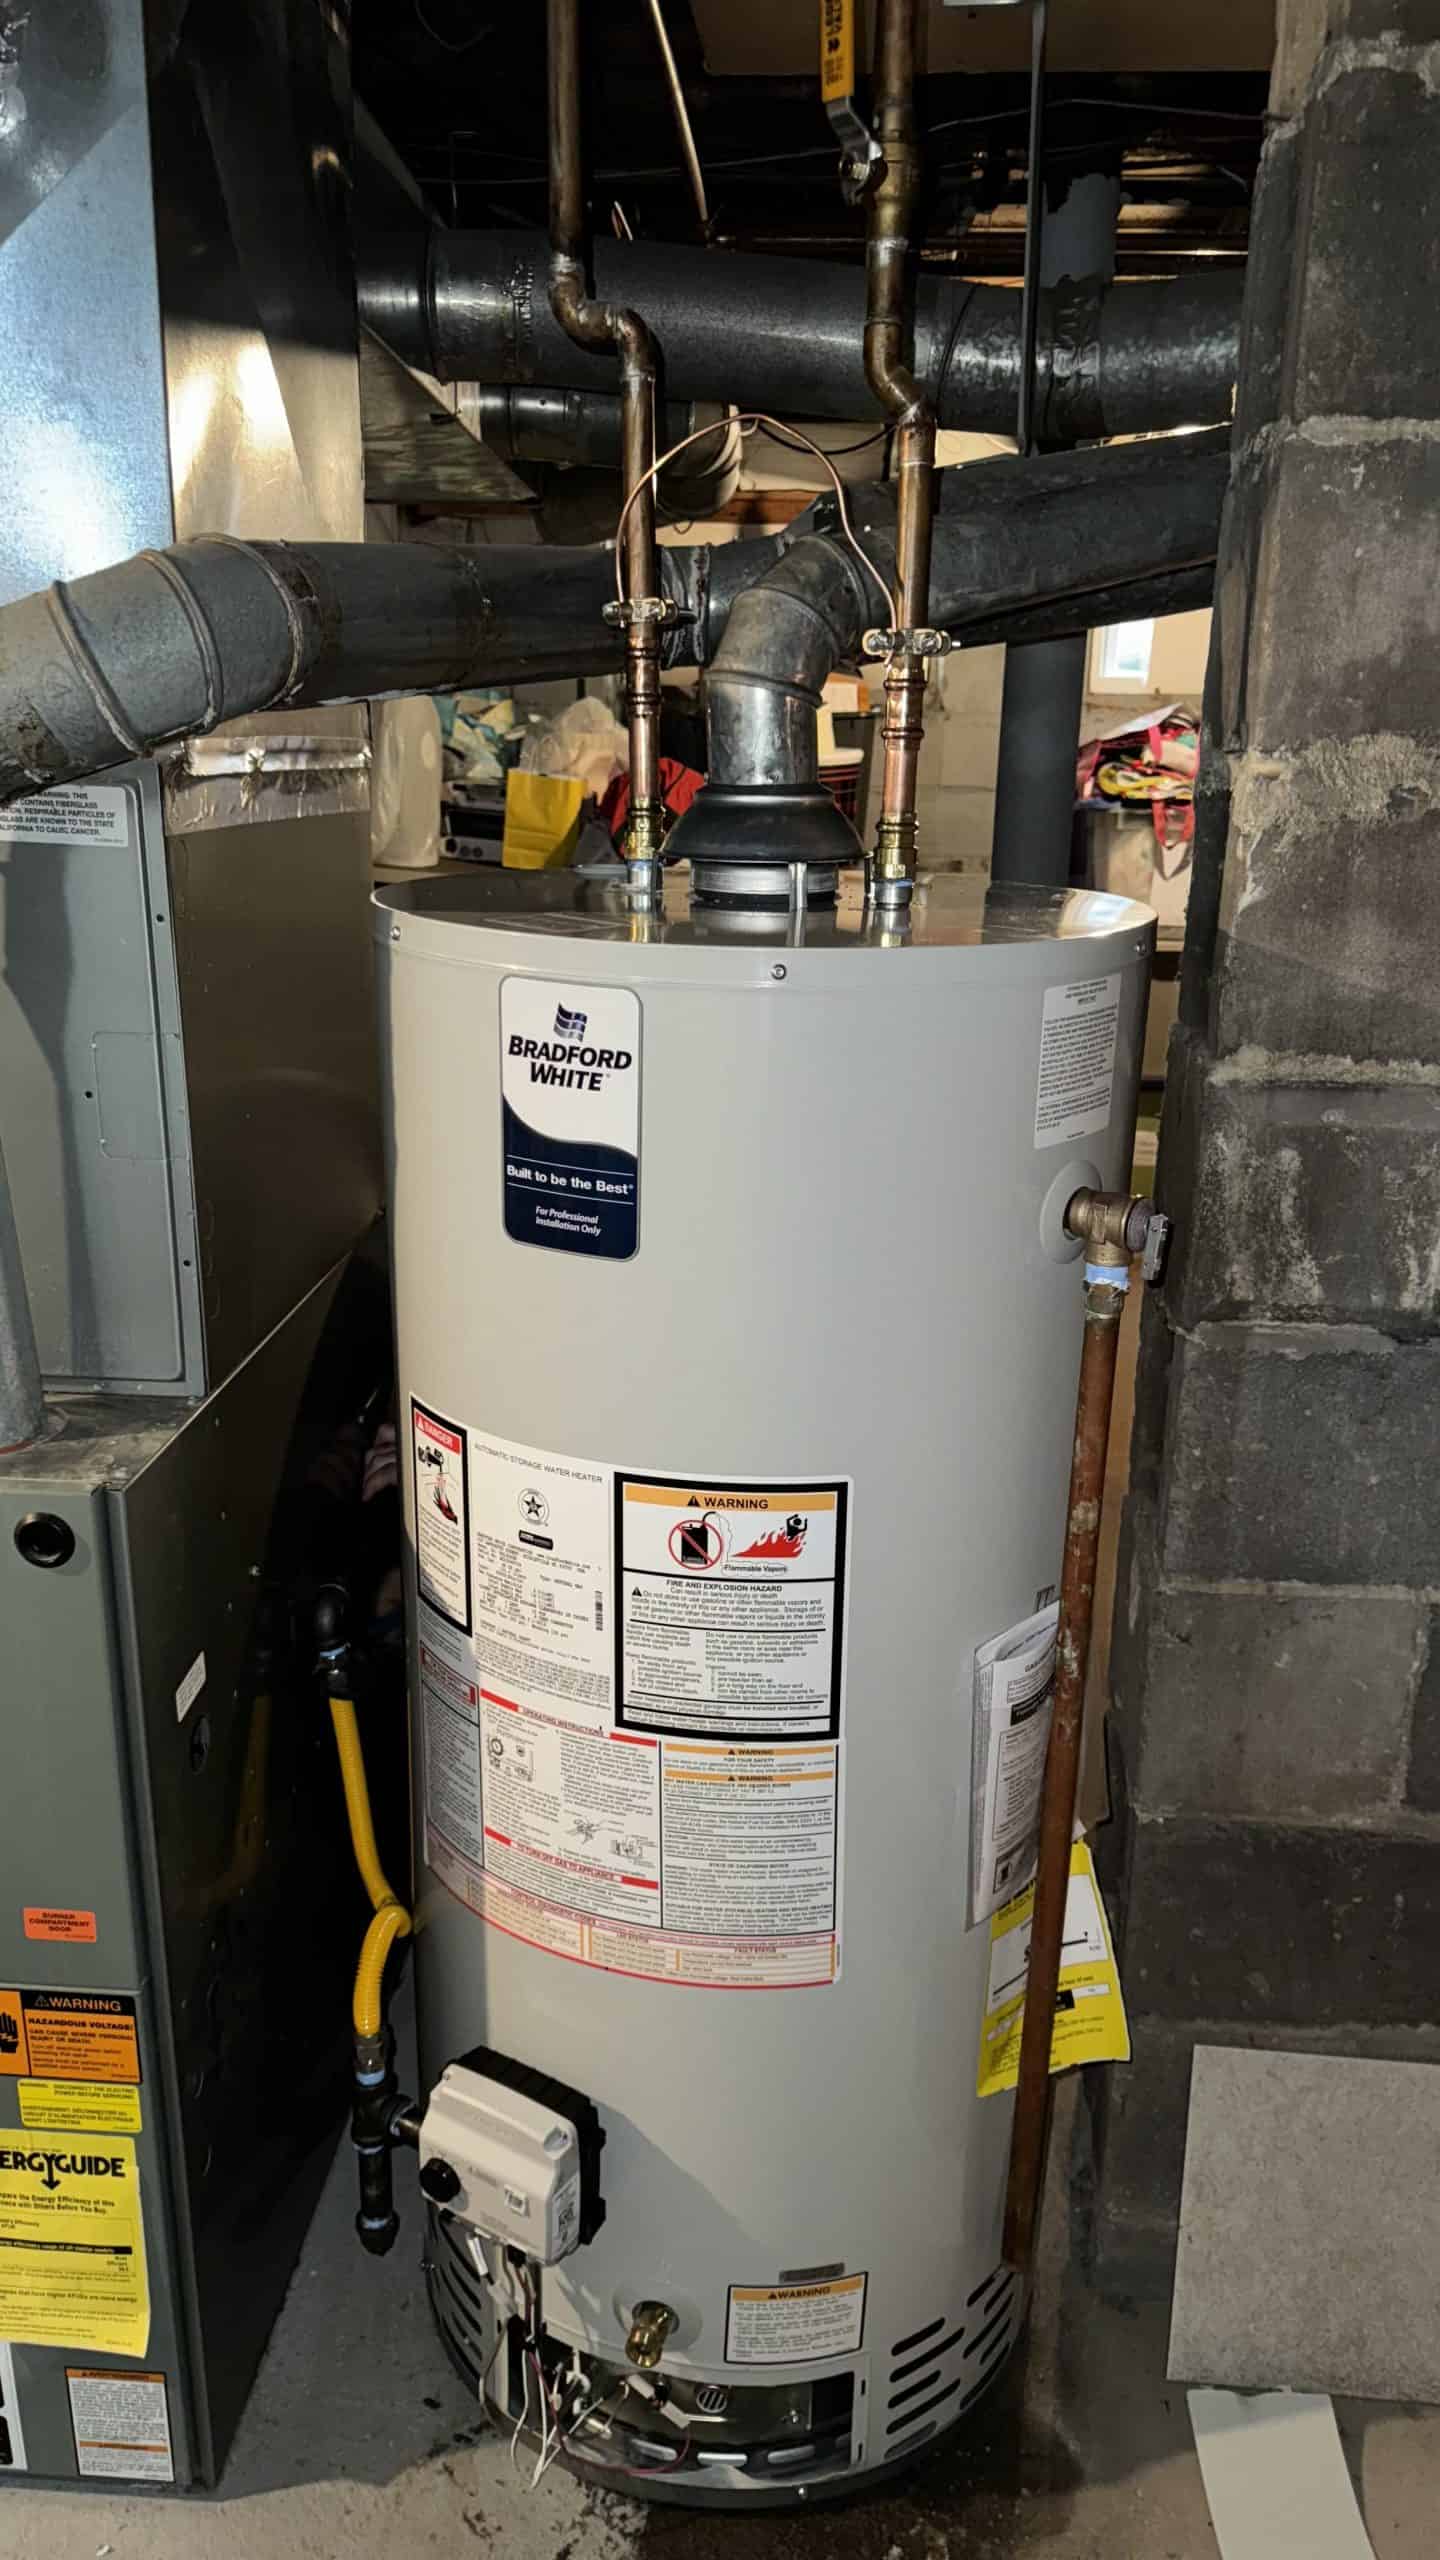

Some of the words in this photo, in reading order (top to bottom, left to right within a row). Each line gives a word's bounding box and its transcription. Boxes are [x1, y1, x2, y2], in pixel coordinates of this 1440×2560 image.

[508, 1034, 632, 1070] BRADFORD
[506, 1164, 532, 1180] Built
[535, 1170, 547, 1183] to
[550, 1173, 567, 1186] be
[571, 1177, 592, 1190] the
[536, 1206, 549, 1216] For
[549, 1208, 599, 1224] Professional
[536, 1217, 580, 1232] Installation
[581, 1223, 601, 1236] Only
[544, 1463, 570, 1478] WATER
[571, 1471, 603, 1483] HEATER
[704, 1497, 768, 1510] WARNING
[666, 1579, 684, 1588] FIRE
[685, 1581, 702, 1589] AND
[703, 1583, 749, 1592] EXPLOSION
[750, 1584, 783, 1592] HAZARD
[48, 1997, 121, 2011] WARNING
[28, 2018, 87, 2028] HAZARDOUS
